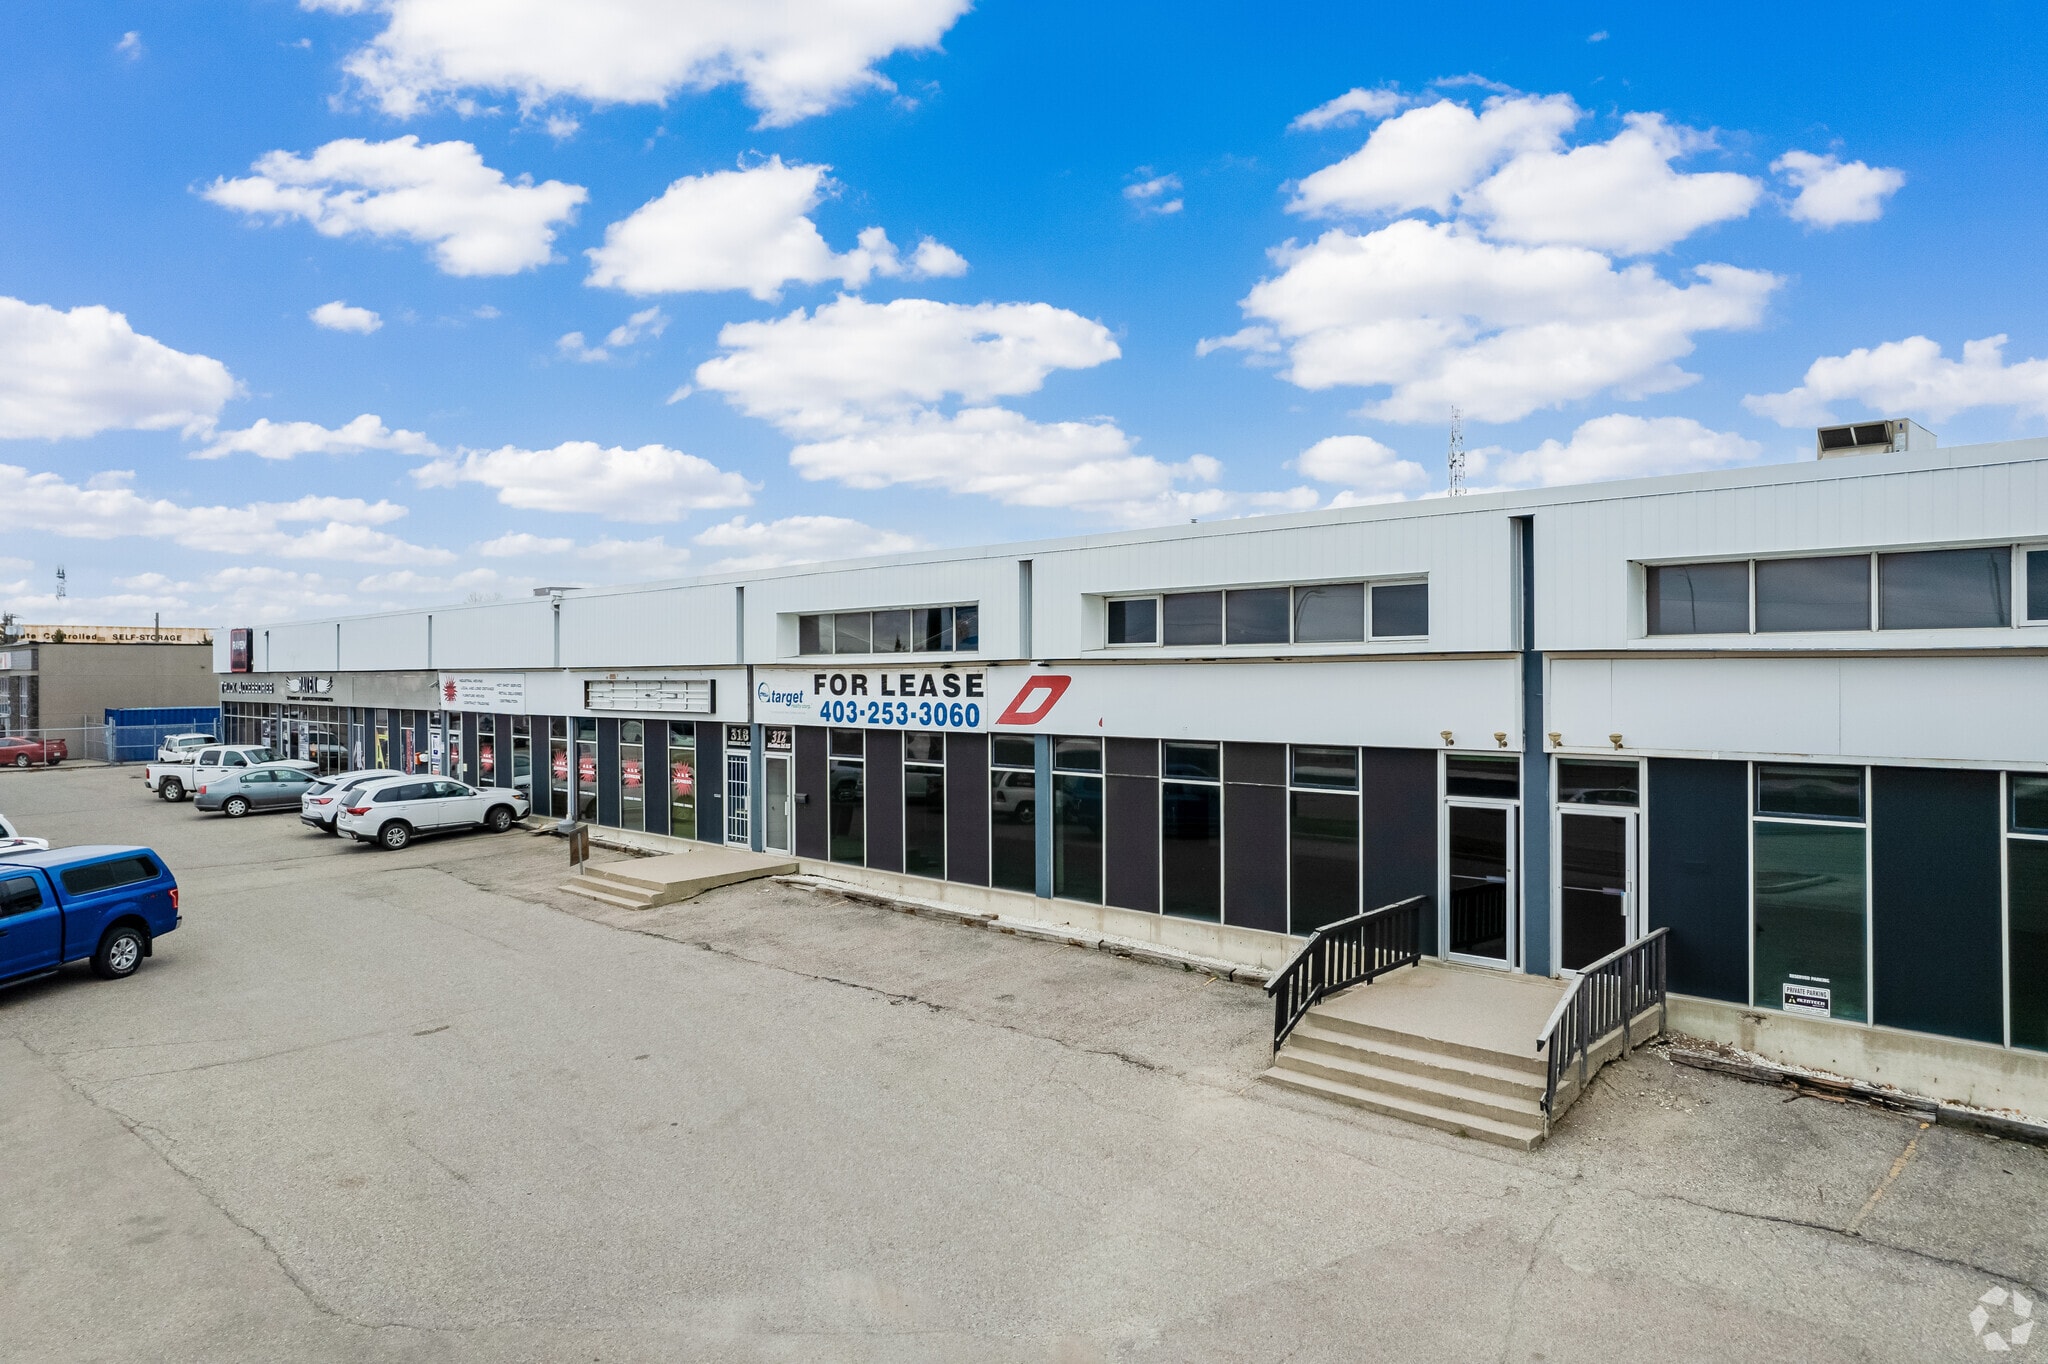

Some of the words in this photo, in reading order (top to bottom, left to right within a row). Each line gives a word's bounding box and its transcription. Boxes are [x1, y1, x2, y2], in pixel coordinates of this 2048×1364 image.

[43, 632, 97, 640] Cotrolled
[112, 633, 182, 641] SELF-STORAGE
[814, 673, 868, 696] FOR
[881, 673, 984, 698] LEASE
[771, 690, 804, 707] target
[771, 730, 787, 744] 312
[1786, 986, 1805, 996] PRIVATE
[1807, 989, 1827, 998] PARKING
